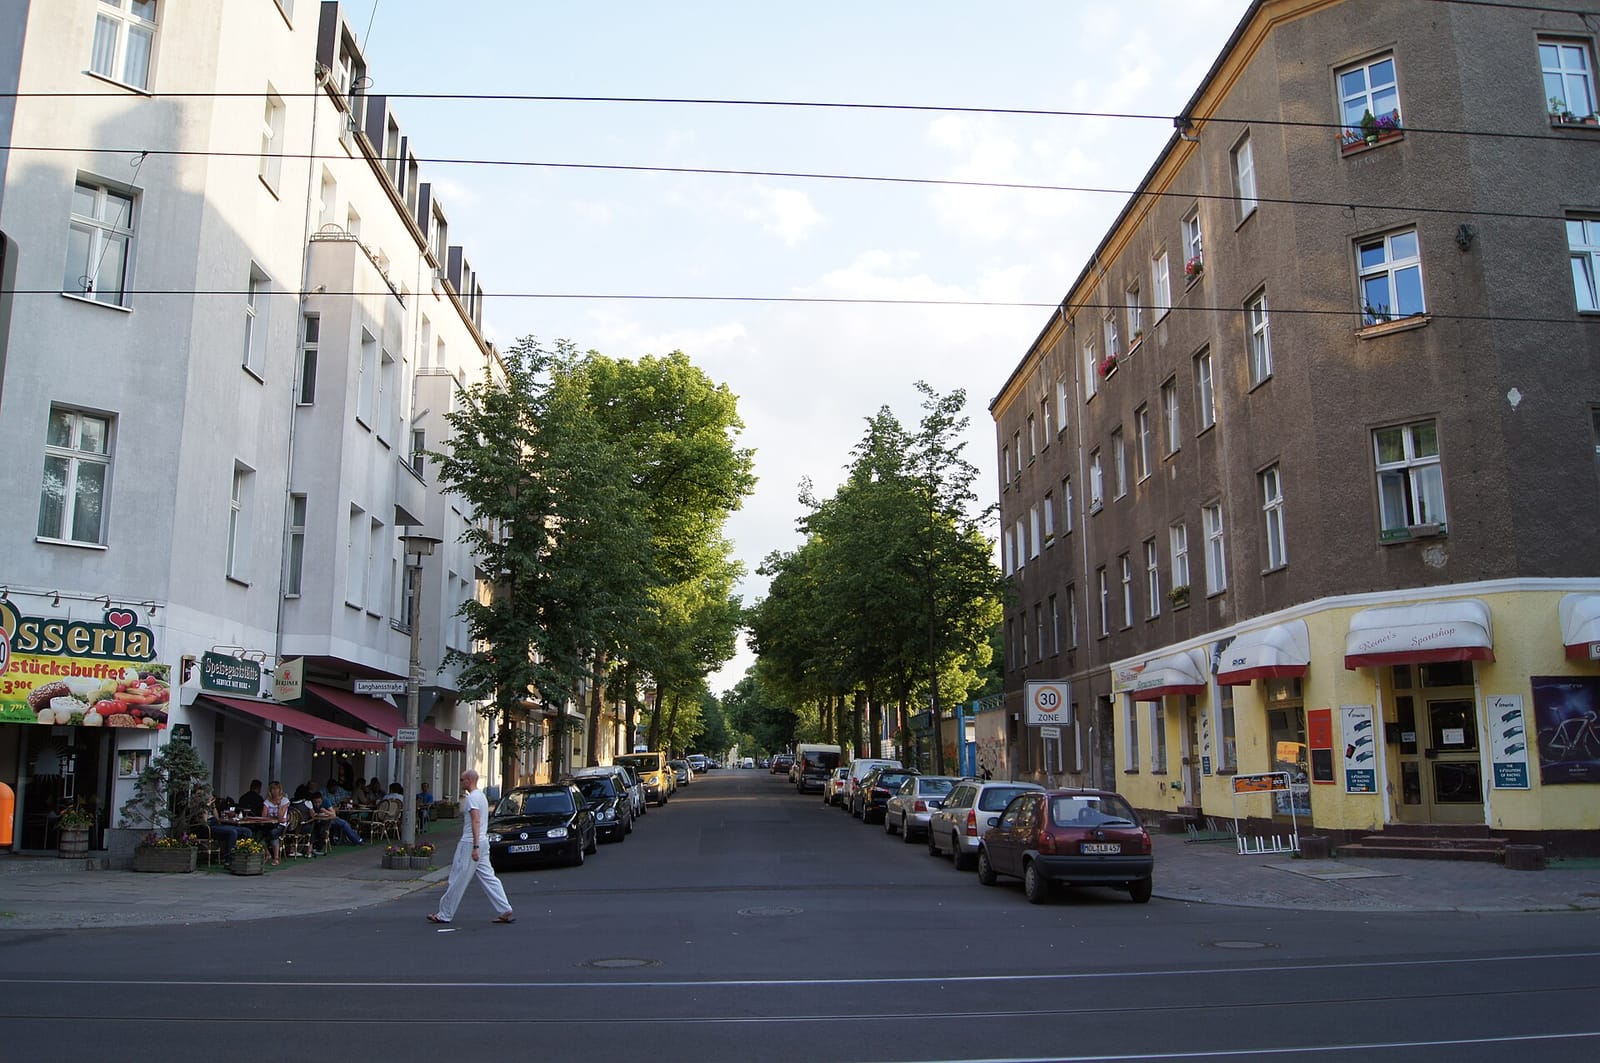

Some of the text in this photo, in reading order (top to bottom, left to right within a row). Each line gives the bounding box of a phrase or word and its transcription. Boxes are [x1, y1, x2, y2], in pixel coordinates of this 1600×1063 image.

[7, 659, 126, 681] stücksbuffet
[358, 683, 402, 691] Langhansstraße
[1040, 693, 1056, 706] 30
